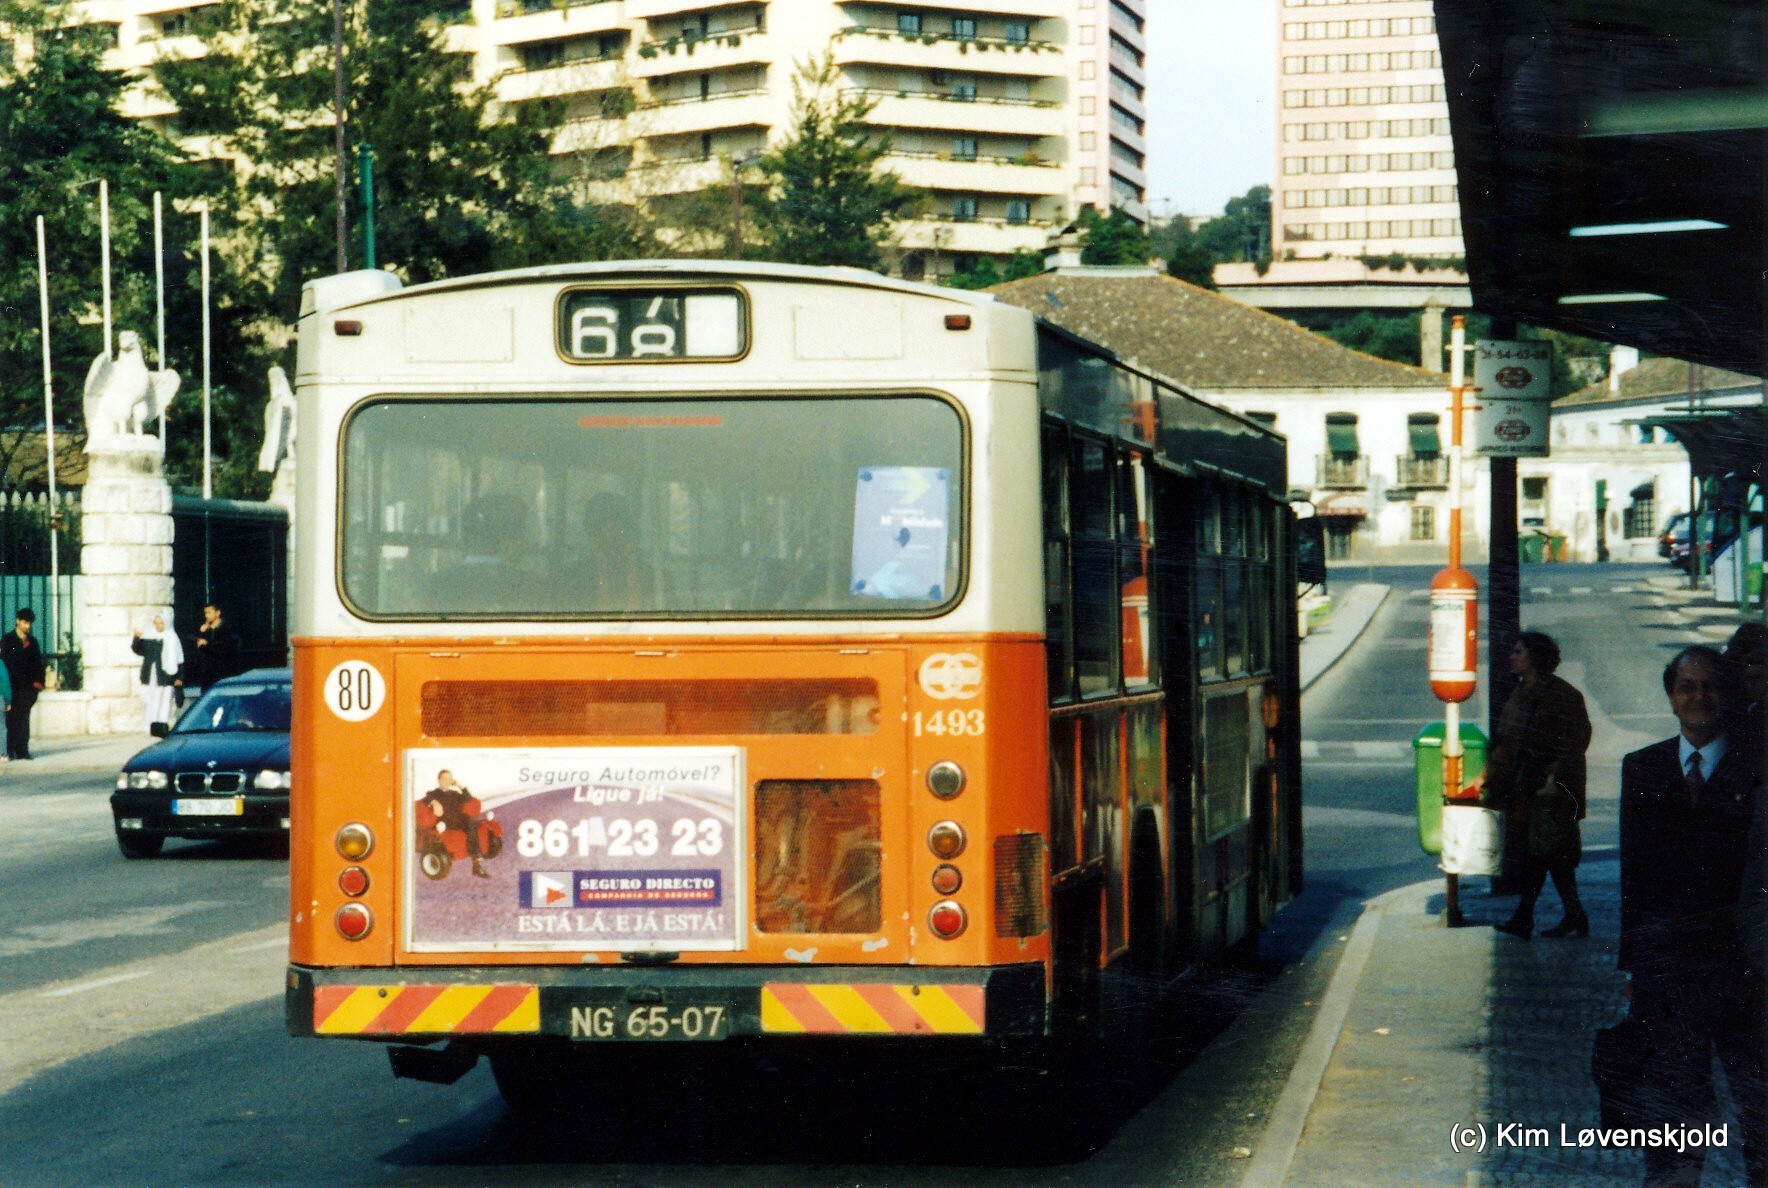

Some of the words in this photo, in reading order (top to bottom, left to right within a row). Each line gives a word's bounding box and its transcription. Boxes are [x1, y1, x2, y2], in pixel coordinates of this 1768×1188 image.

[338, 668, 371, 711] 80
[913, 708, 986, 738] 1493
[518, 767, 590, 785] Seguro
[599, 765, 721, 782] Automóvel?
[573, 785, 632, 806] Ligue
[516, 818, 590, 858] 861
[607, 818, 660, 857] 23
[671, 817, 724, 857] 23
[579, 878, 642, 891] SEGURO
[645, 877, 715, 890] DIRECTO
[517, 911, 572, 933] ESTÁ
[616, 914, 630, 932] E
[664, 910, 725, 932] ESTÁ!
[571, 1006, 615, 1037] NG
[626, 1006, 726, 1037] 65-07
